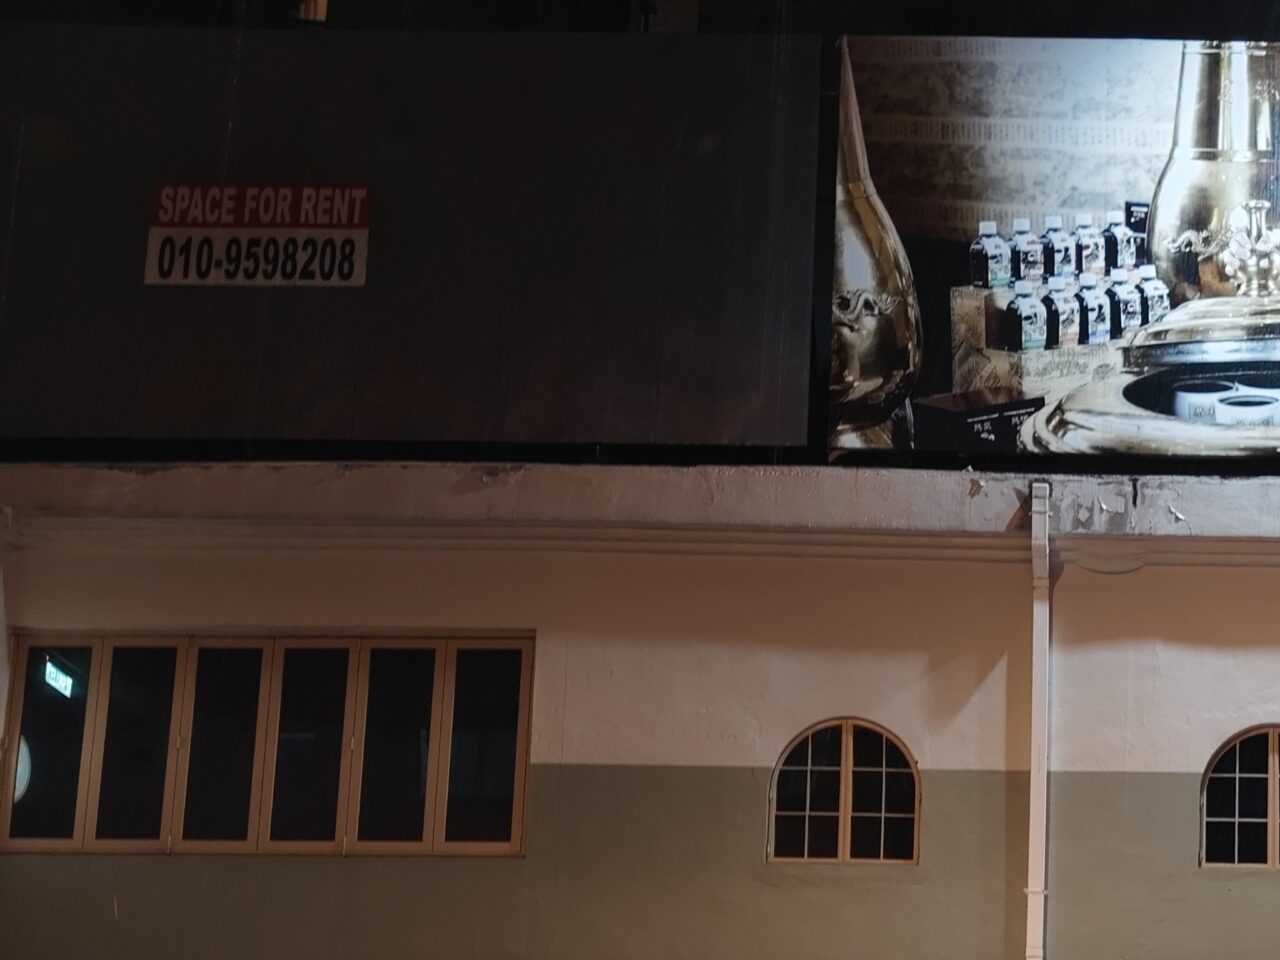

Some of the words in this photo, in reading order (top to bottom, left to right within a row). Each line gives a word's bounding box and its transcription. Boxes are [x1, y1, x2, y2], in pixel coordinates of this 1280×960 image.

[158, 186, 237, 223] SPACE
[244, 187, 292, 223] FOR
[300, 187, 367, 224] RENT
[158, 236, 356, 281] 010-9598208
